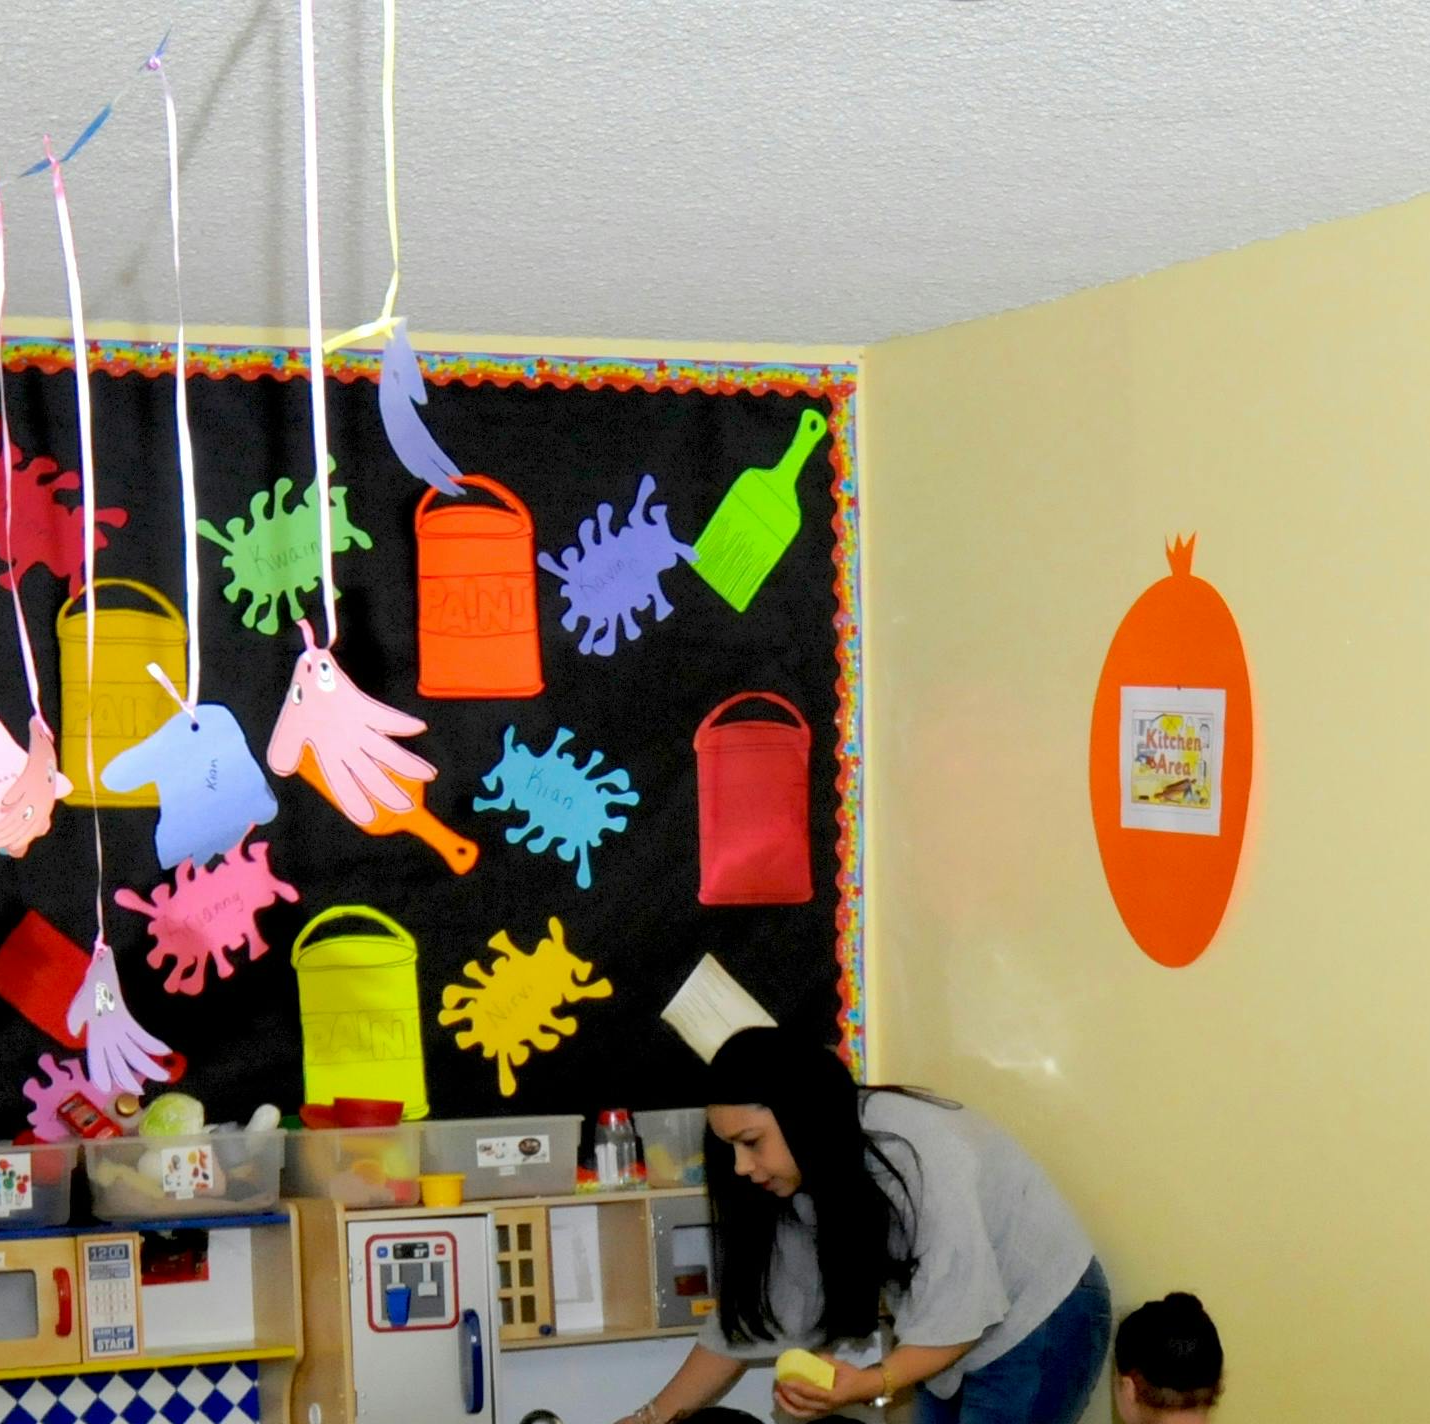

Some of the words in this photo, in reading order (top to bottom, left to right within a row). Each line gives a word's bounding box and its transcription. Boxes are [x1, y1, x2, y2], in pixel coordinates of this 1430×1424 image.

[423, 577, 532, 634] PAINT
[1146, 727, 1203, 751] Kitchen
[1155, 753, 1191, 776] Area
[96, 1339, 131, 1351] START
